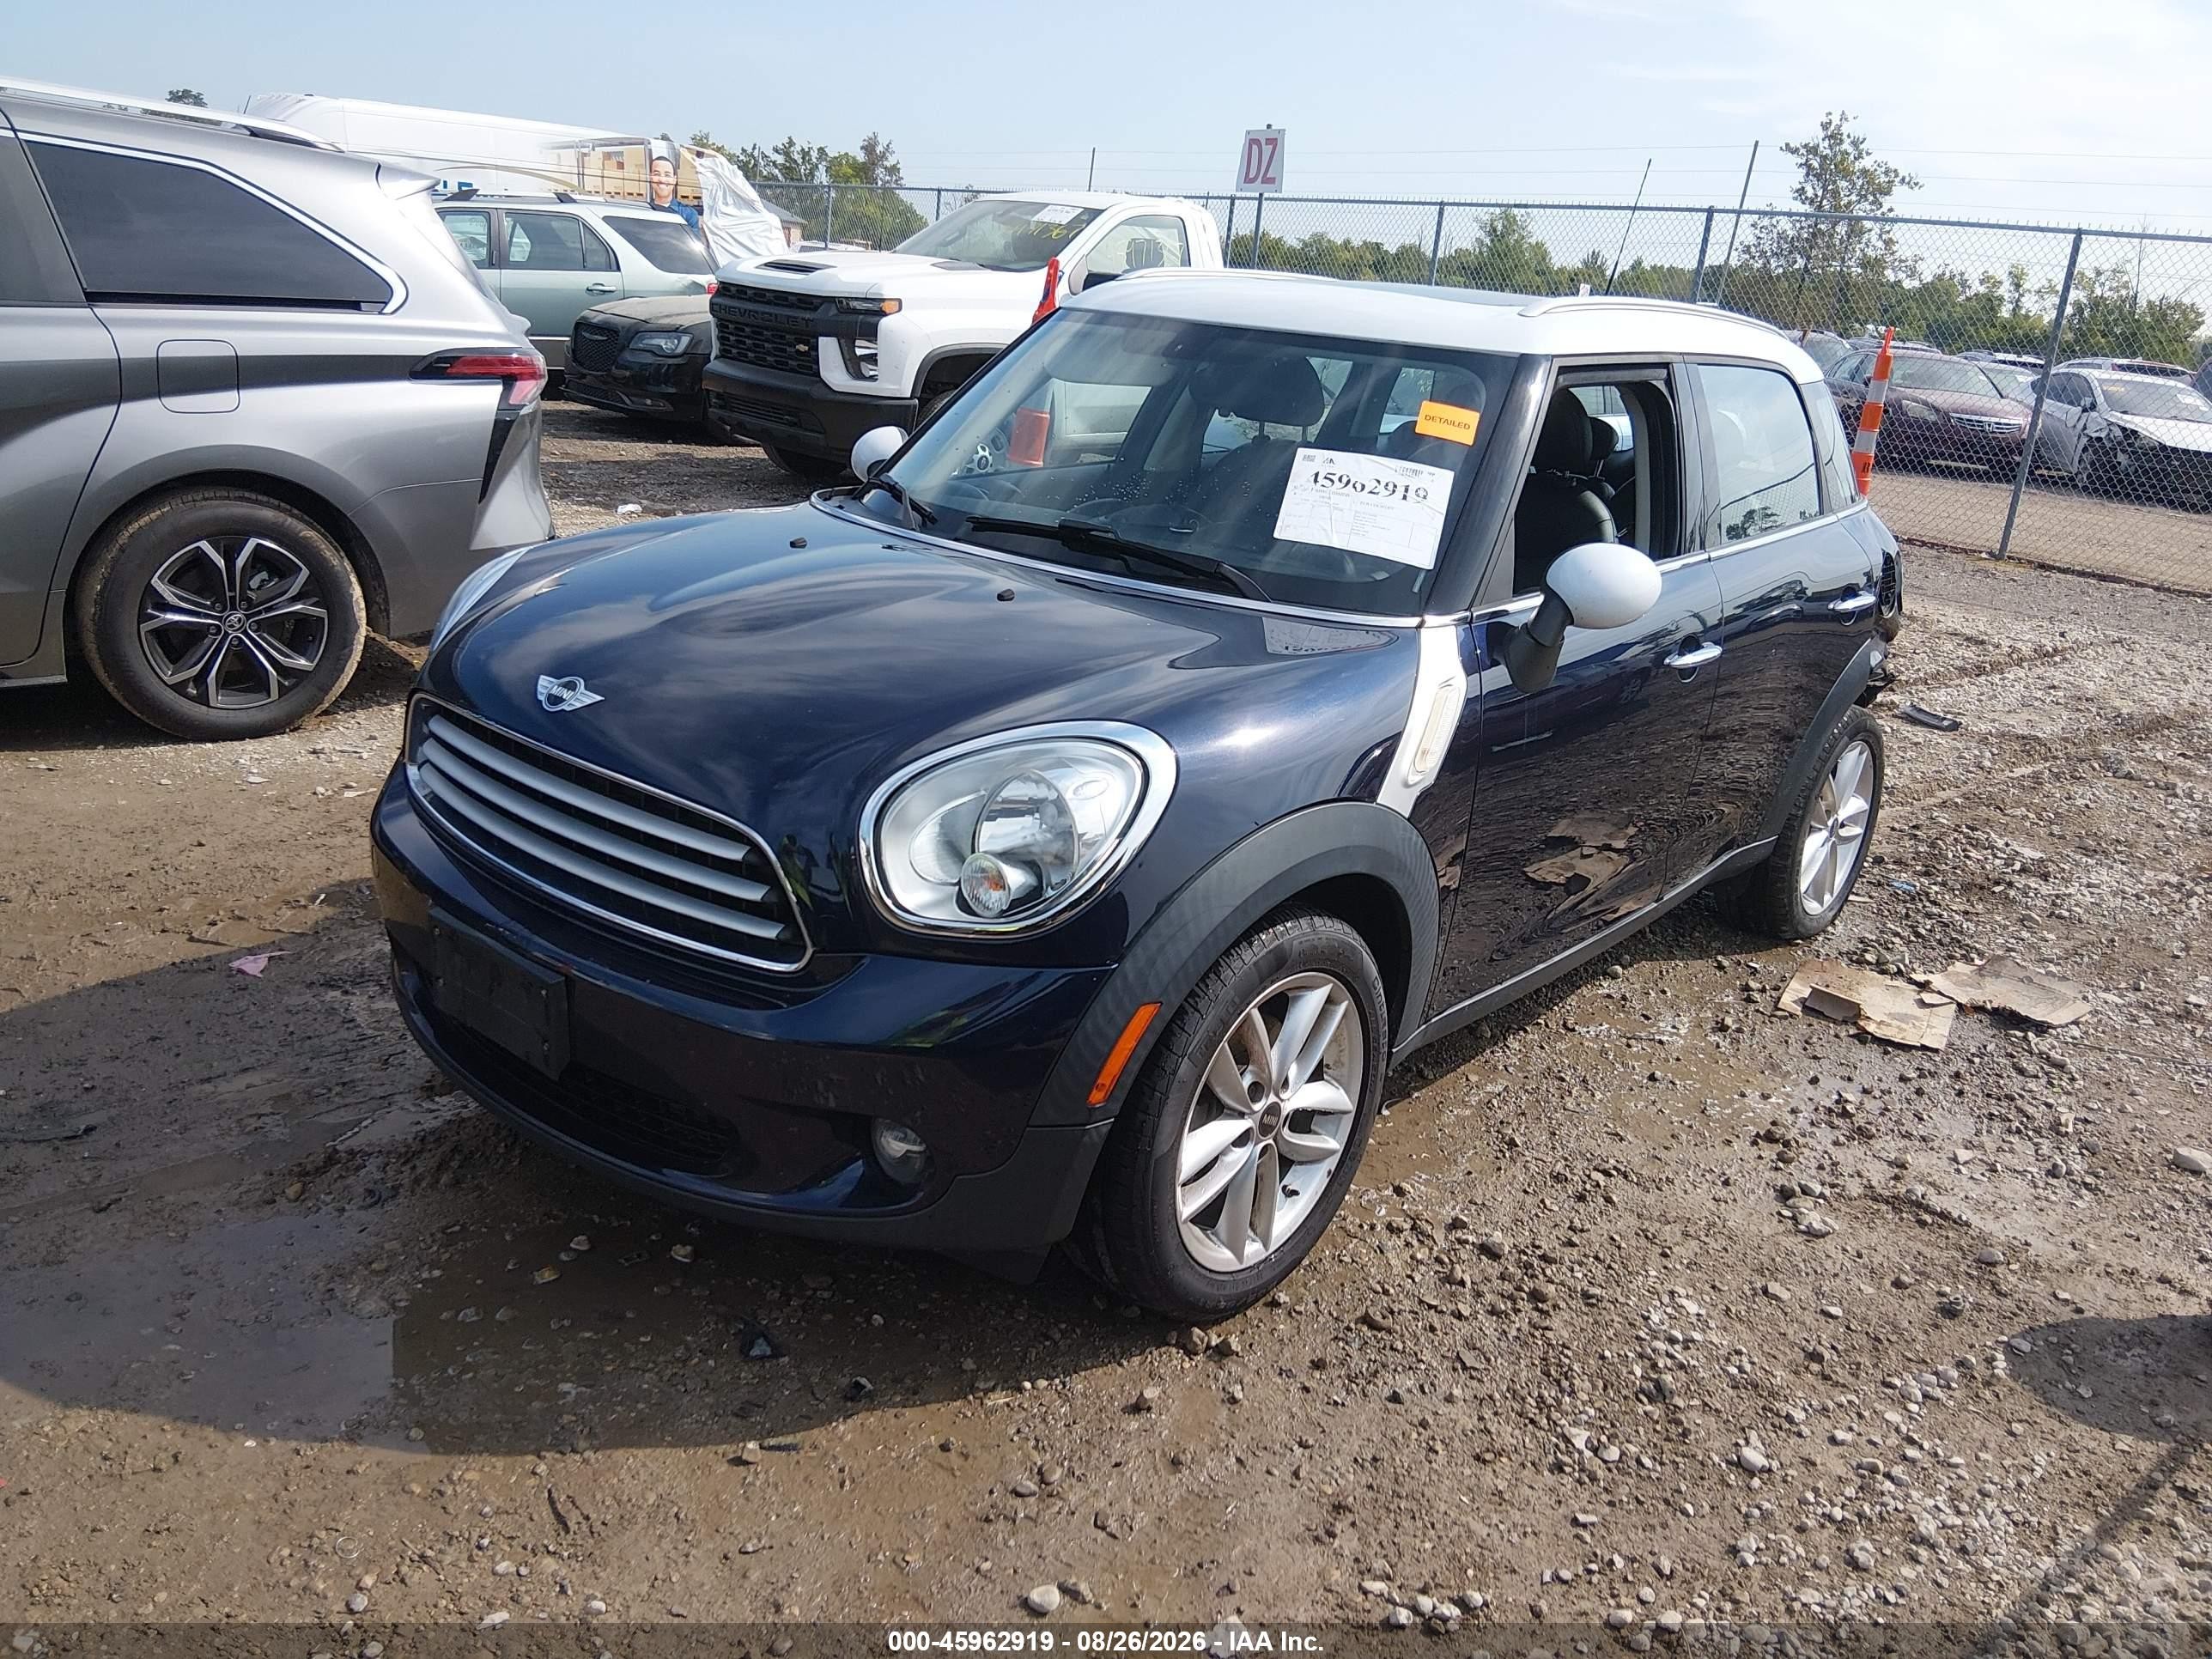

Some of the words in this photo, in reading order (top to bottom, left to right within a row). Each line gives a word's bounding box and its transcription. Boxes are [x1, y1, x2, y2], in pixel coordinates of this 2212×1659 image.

[1243, 138, 1278, 185] DZ
[710, 302, 814, 329] CHEVROLET
[1424, 415, 1471, 430] DETAILED
[549, 685, 574, 701] MINI
[1262, 1114, 1279, 1127] MINI
